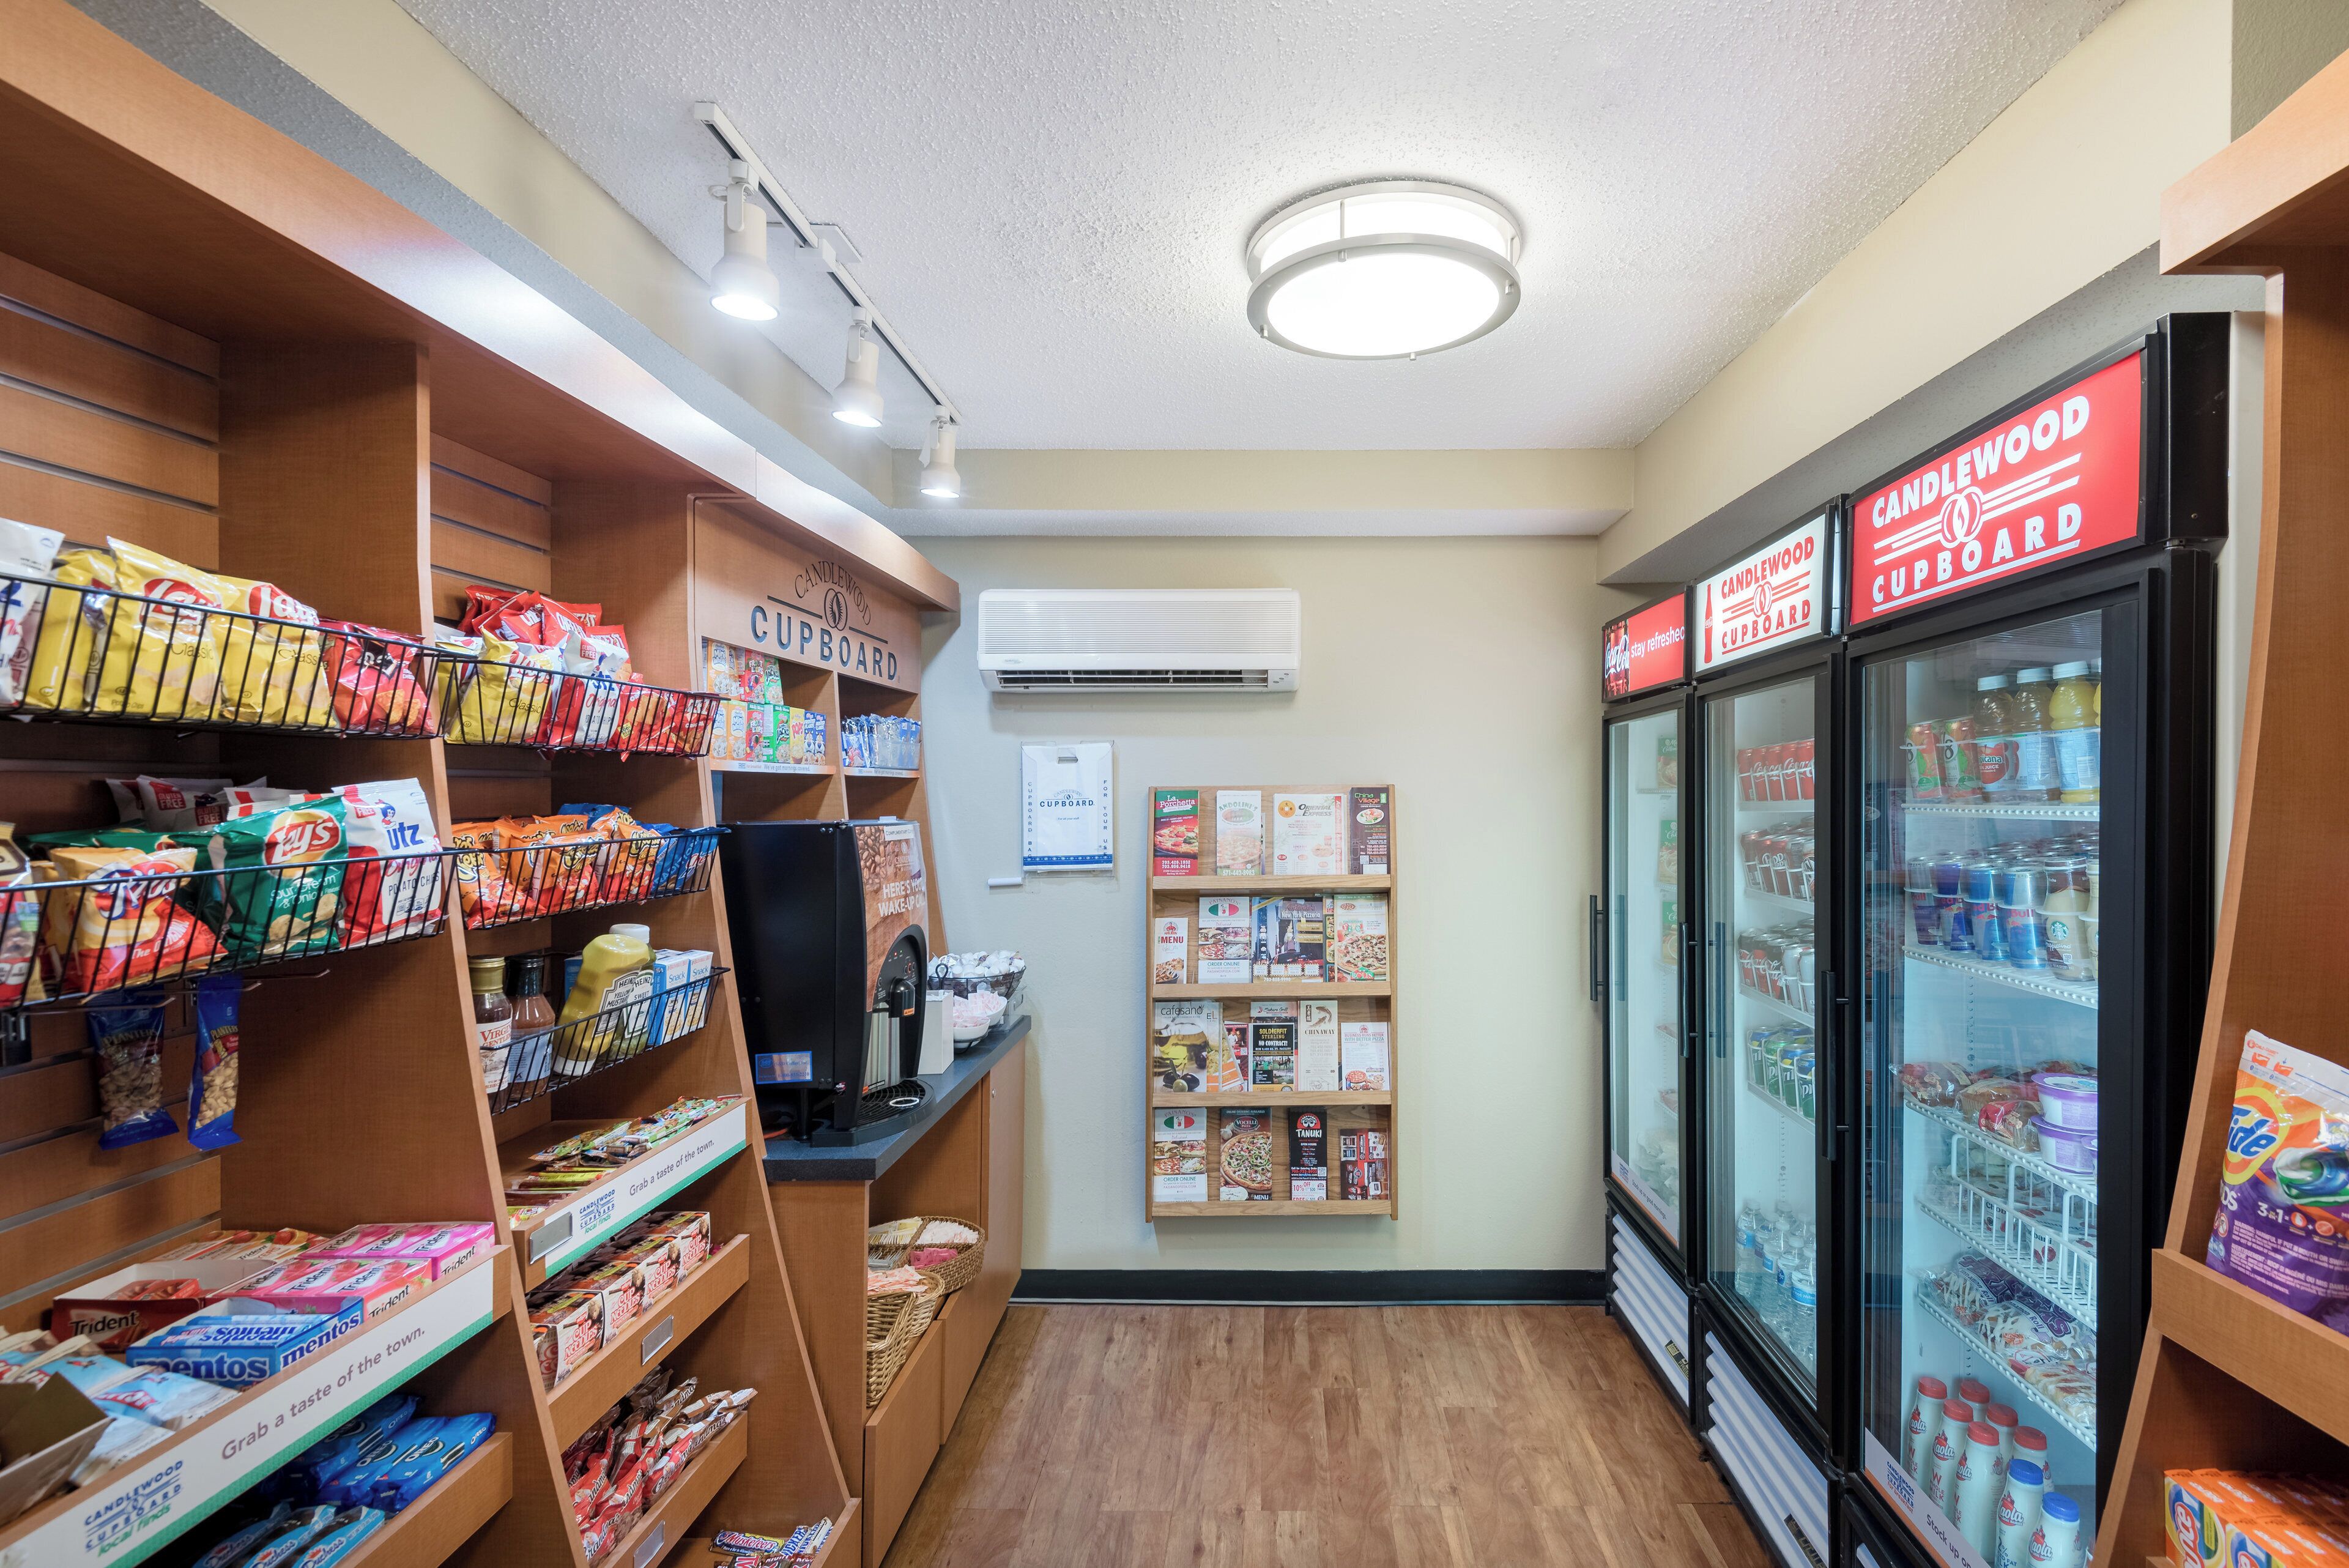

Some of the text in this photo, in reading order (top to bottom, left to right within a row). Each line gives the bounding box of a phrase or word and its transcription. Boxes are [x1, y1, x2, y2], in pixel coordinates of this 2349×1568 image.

[1871, 395, 2090, 529] CANDLEWOOD
[1872, 502, 2082, 604] CUPBOARD
[1721, 535, 1814, 600] CANDLEWOOD
[795, 561, 871, 625] CANDLEWOOD
[1721, 599, 1811, 649] CUPBOARD
[581, 650, 596, 660] FREE
[751, 605, 897, 681] CUPBOARD
[1631, 642, 1646, 660] stay
[509, 697, 541, 714] Classic
[776, 728, 790, 743] JACKS
[792, 722, 803, 739] POPS
[160, 798, 184, 809] FREE
[1053, 789, 1083, 798] CANDLEWOOD
[1160, 799, 1195, 808] Porchetta
[1219, 801, 1258, 812] ANDOLINI'S
[198, 814, 221, 825] FREE
[357, 806, 375, 817] FREE
[271, 819, 333, 864] Lay's
[386, 822, 424, 851] utz
[883, 880, 910, 899] HERE'S
[878, 896, 915, 917] WAKE-UP
[634, 976, 651, 987] HEINZ
[669, 972, 685, 983] Snack
[692, 965, 708, 977] Snack
[634, 990, 650, 1001] SWEET
[1160, 1005, 1203, 1016] cafesano
[1296, 1129, 1322, 1138] TANUKI
[2229, 1104, 2280, 1160] Tide
[629, 1140, 715, 1197] Grab a taste of the town.
[579, 1189, 615, 1214] CANDLEWOOD
[580, 1203, 615, 1228] CUPBOARD
[584, 1213, 612, 1235] local finds
[237, 1245, 268, 1260] Trident
[321, 1229, 360, 1253] Trident
[366, 1228, 405, 1254] Trident
[412, 1228, 452, 1254] Trident
[681, 1241, 707, 1265] NOODLES
[688, 1234, 703, 1252] CUP
[441, 1246, 476, 1275] Trident
[654, 1258, 671, 1280] CUP
[240, 1264, 287, 1292] Trident
[290, 1265, 335, 1292] Trident
[341, 1265, 381, 1292] Trident
[647, 1266, 675, 1296] NOODLES
[368, 1285, 410, 1318] Trident
[610, 1292, 640, 1324] NOODLES
[617, 1287, 636, 1308] CUP
[70, 1311, 139, 1337] Trident
[572, 1319, 592, 1341] CUP
[280, 1312, 361, 1369] mentos
[563, 1326, 598, 1361] NOODLES
[221, 1326, 425, 1462] Grab a taste of the town.
[470, 1426, 488, 1446] OREO
[357, 1440, 394, 1468] OREO
[404, 1436, 440, 1463] OREO
[1887, 1461, 1915, 1495] CANDLEWOOD
[1887, 1474, 1914, 1507] CUPBOARD
[84, 1460, 184, 1526] CANDLEWOOD
[1894, 1489, 1913, 1514] breakfast
[85, 1484, 182, 1549] CUPBOARD
[98, 1503, 171, 1558] local finds
[725, 1533, 775, 1550] Musketeers
[1926, 1514, 1972, 1568] Stock up on
[252, 1539, 298, 1568] Duchess
[303, 1537, 346, 1568] Duchess
